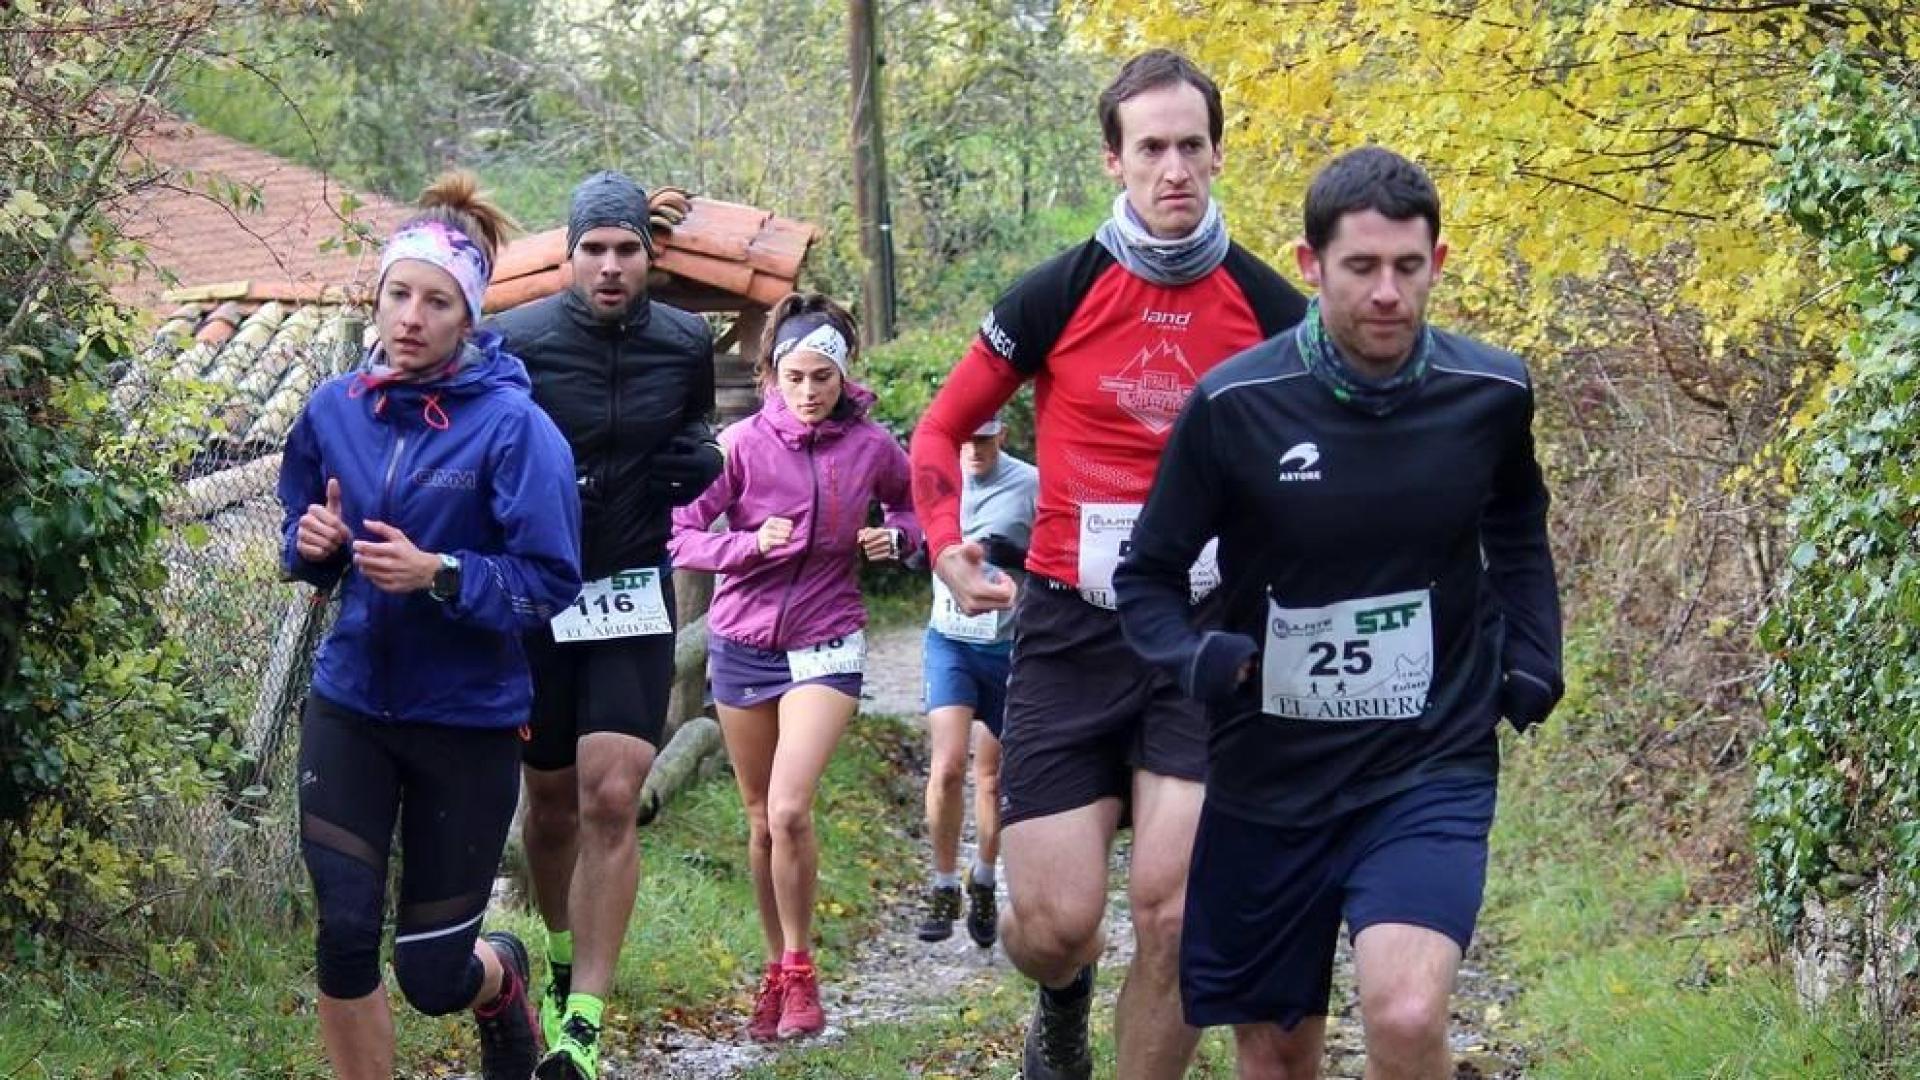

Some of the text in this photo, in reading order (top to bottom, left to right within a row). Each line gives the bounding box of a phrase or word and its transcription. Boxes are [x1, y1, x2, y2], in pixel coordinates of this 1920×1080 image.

[1142, 307, 1192, 325] land
[1279, 471, 1322, 482] ASTORE
[611, 571, 655, 591] SIF
[574, 593, 635, 614] 116
[1354, 601, 1423, 635] SIF
[1308, 639, 1373, 677] 25
[1274, 697, 1309, 717] EL
